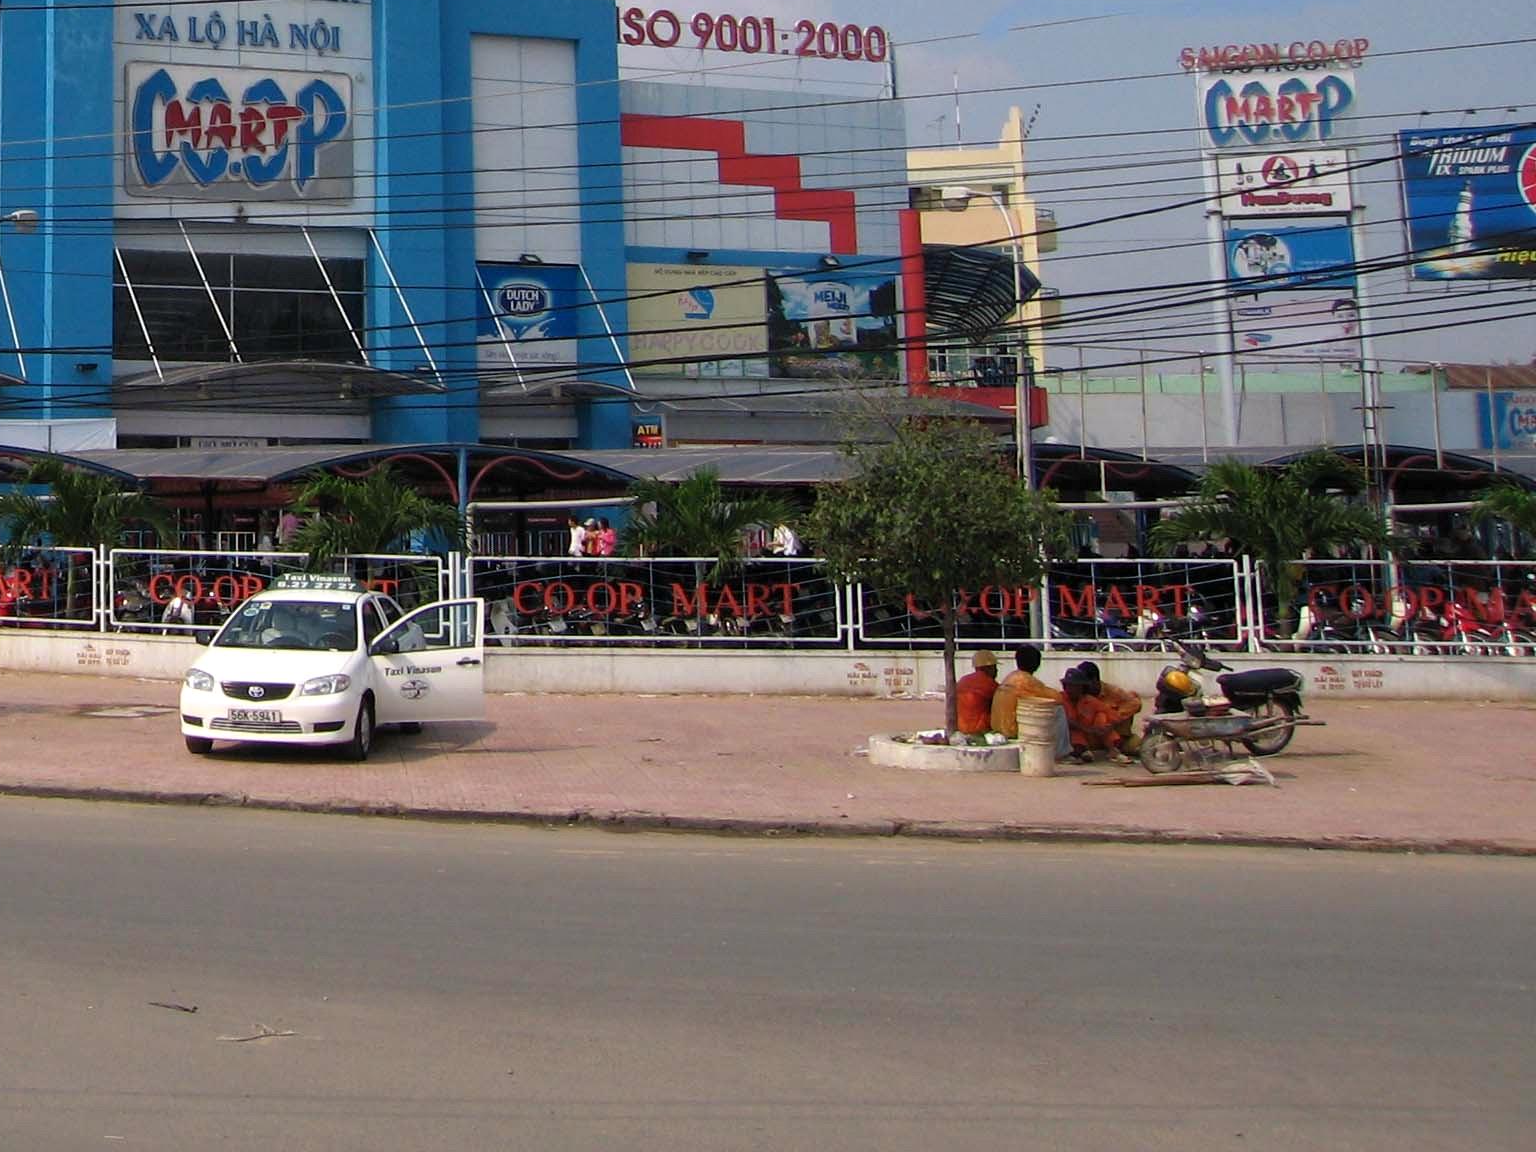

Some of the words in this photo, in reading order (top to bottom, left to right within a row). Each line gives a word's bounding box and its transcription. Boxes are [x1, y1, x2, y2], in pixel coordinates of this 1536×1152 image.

[134, 13, 178, 42] XA
[188, 10, 226, 49] LỘ
[237, 14, 280, 47] HÀ
[289, 18, 341, 55] NỘI
[1181, 43, 1281, 70] SAIGON
[1226, 92, 1322, 125] MART
[164, 100, 306, 153] MART
[1428, 147, 1508, 176] IRIDIUM
[506, 289, 539, 301] DUTCH
[510, 300, 535, 312] LADY
[814, 290, 848, 305] MEIJI
[637, 424, 659, 435] ATM
[284, 573, 306, 581] Taxi
[309, 574, 351, 583] Vinasun
[671, 583, 801, 617] MART
[1059, 584, 1194, 618] MART
[384, 666, 404, 677] Taxi
